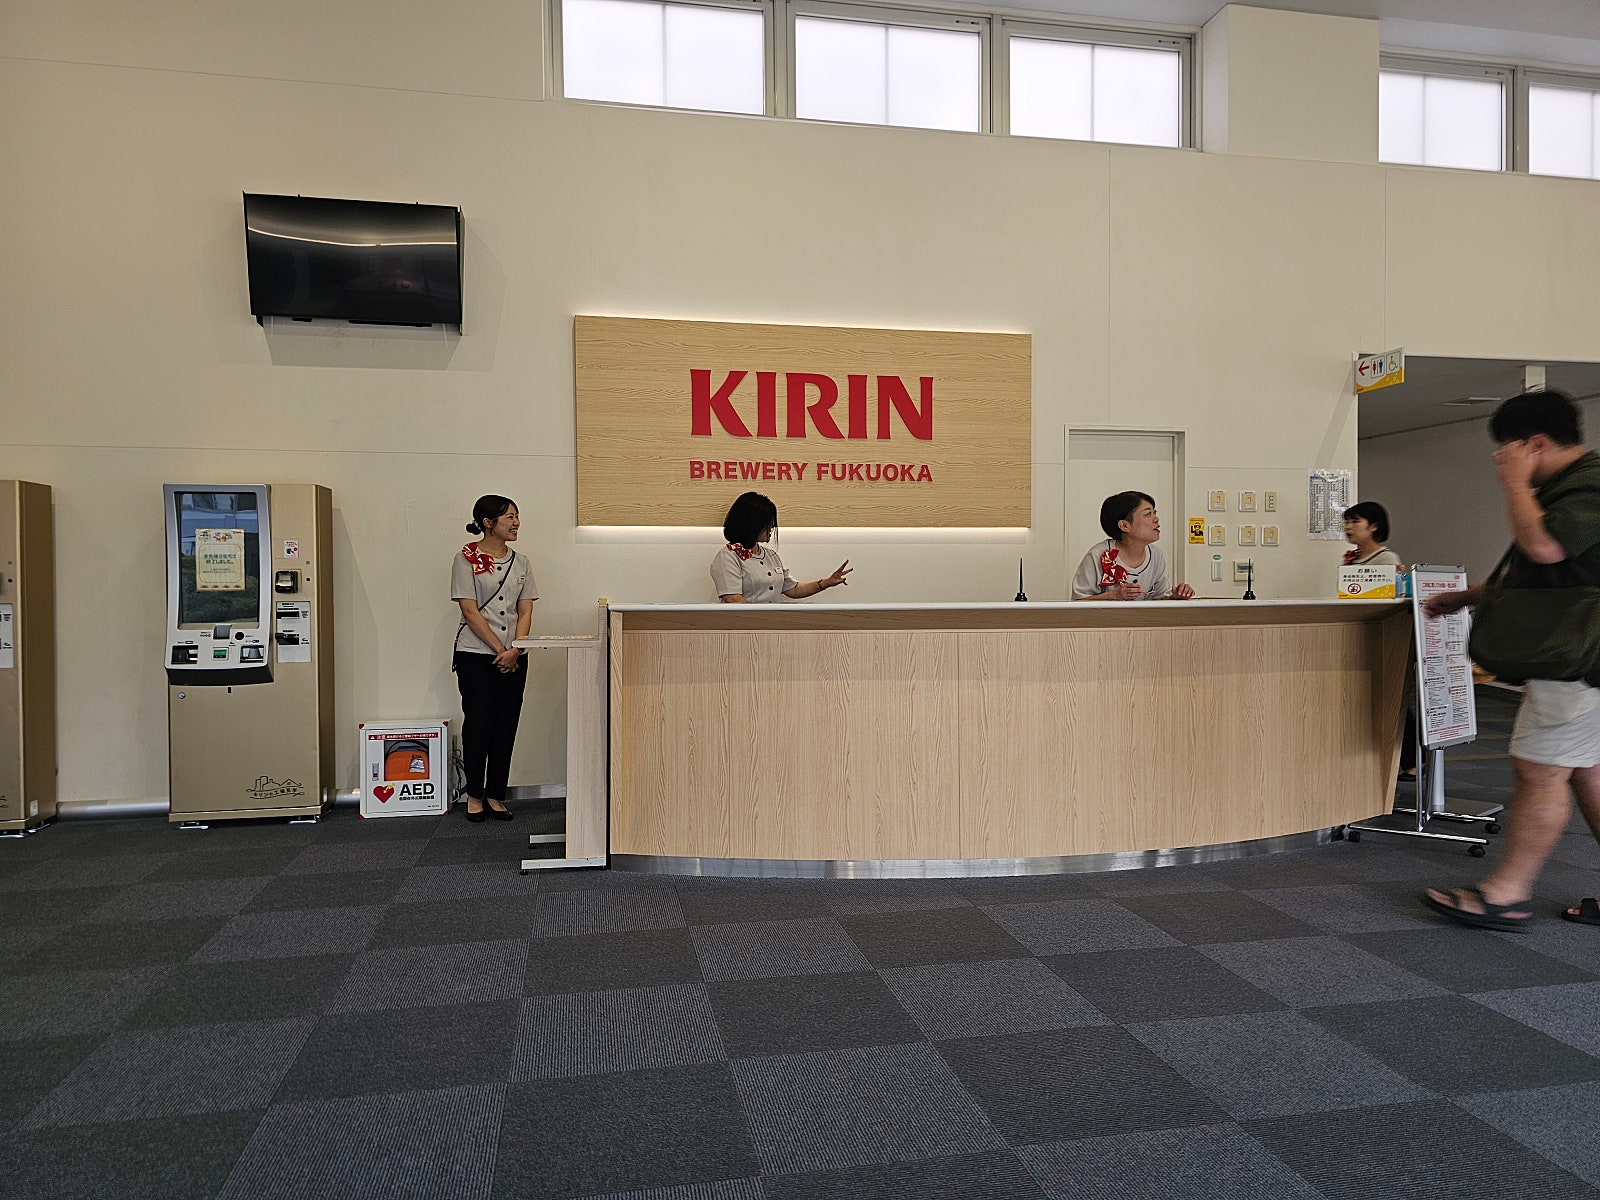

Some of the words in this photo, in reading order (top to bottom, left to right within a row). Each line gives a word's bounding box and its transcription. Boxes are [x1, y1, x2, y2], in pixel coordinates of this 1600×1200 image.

[690, 369, 933, 440] KIRIN
[690, 461, 809, 481] BREWERY
[816, 463, 933, 482] FUKUOKA
[253, 787, 298, 798] キリンの工場見学
[399, 783, 434, 796] AED
